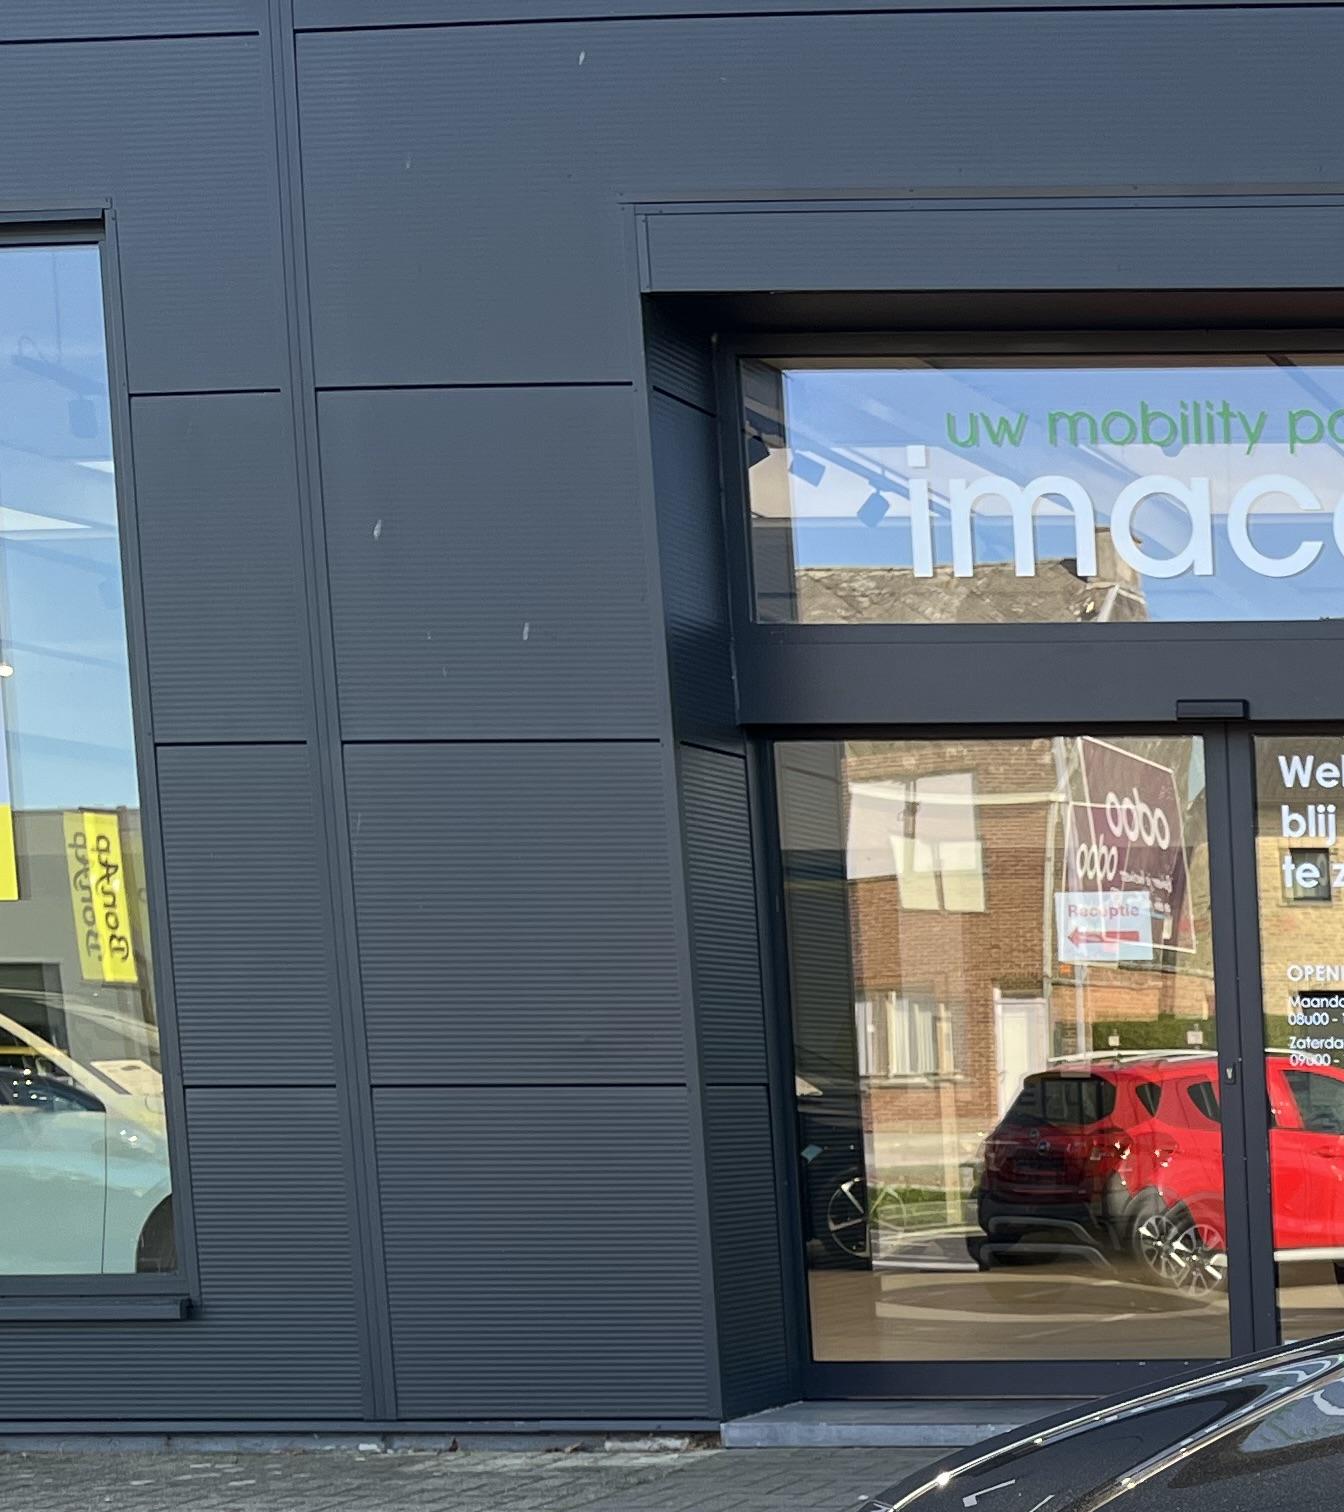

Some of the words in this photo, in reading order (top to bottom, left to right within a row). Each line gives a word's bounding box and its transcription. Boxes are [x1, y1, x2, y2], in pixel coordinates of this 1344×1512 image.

[947, 411, 1029, 448] uw
[1048, 400, 1267, 454] mobility
[1282, 805, 1336, 846] blij
[1283, 856, 1320, 888] te
[1287, 1013, 1329, 1026] 08u00
[1289, 1053, 1331, 1067] 09u00
